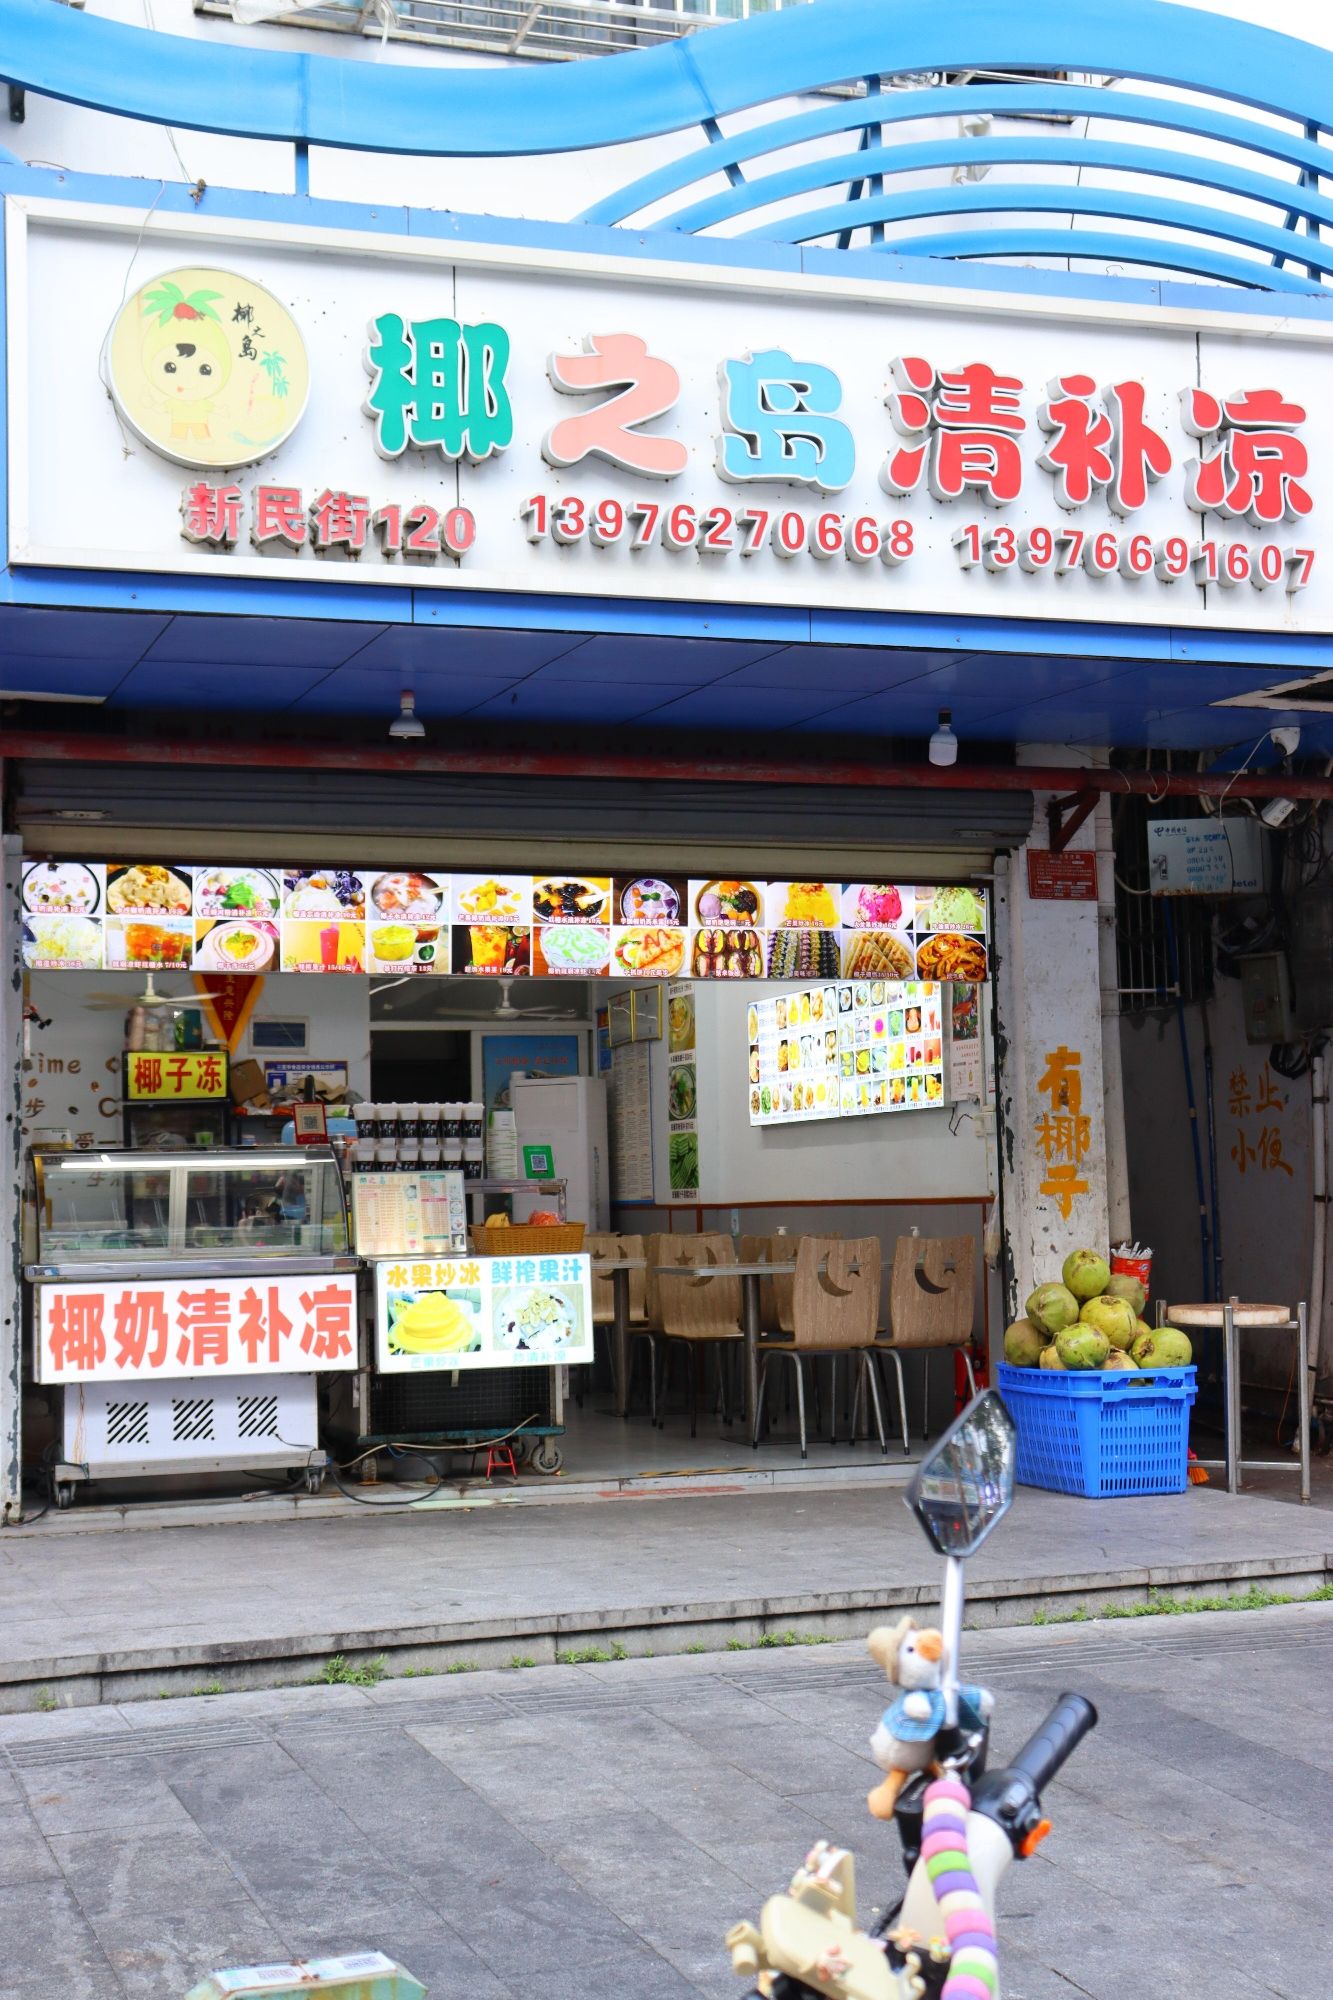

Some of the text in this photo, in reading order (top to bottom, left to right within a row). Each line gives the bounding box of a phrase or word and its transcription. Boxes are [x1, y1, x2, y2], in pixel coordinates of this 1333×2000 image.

[369, 313, 1314, 520] 椰之岛清补凉
[187, 482, 476, 553] 新民街120
[528, 494, 1316, 593] 13976270668 13976691607
[134, 1056, 223, 1094] 椰子冻
[1227, 1060, 1284, 1118] 禁止
[1034, 1045, 1092, 1222] 有椰子
[1230, 1126, 1295, 1177] 小便
[386, 1258, 584, 1288] 水果炒冰 鲜榨果汁
[48, 1283, 353, 1372] 椰奶清补凉
